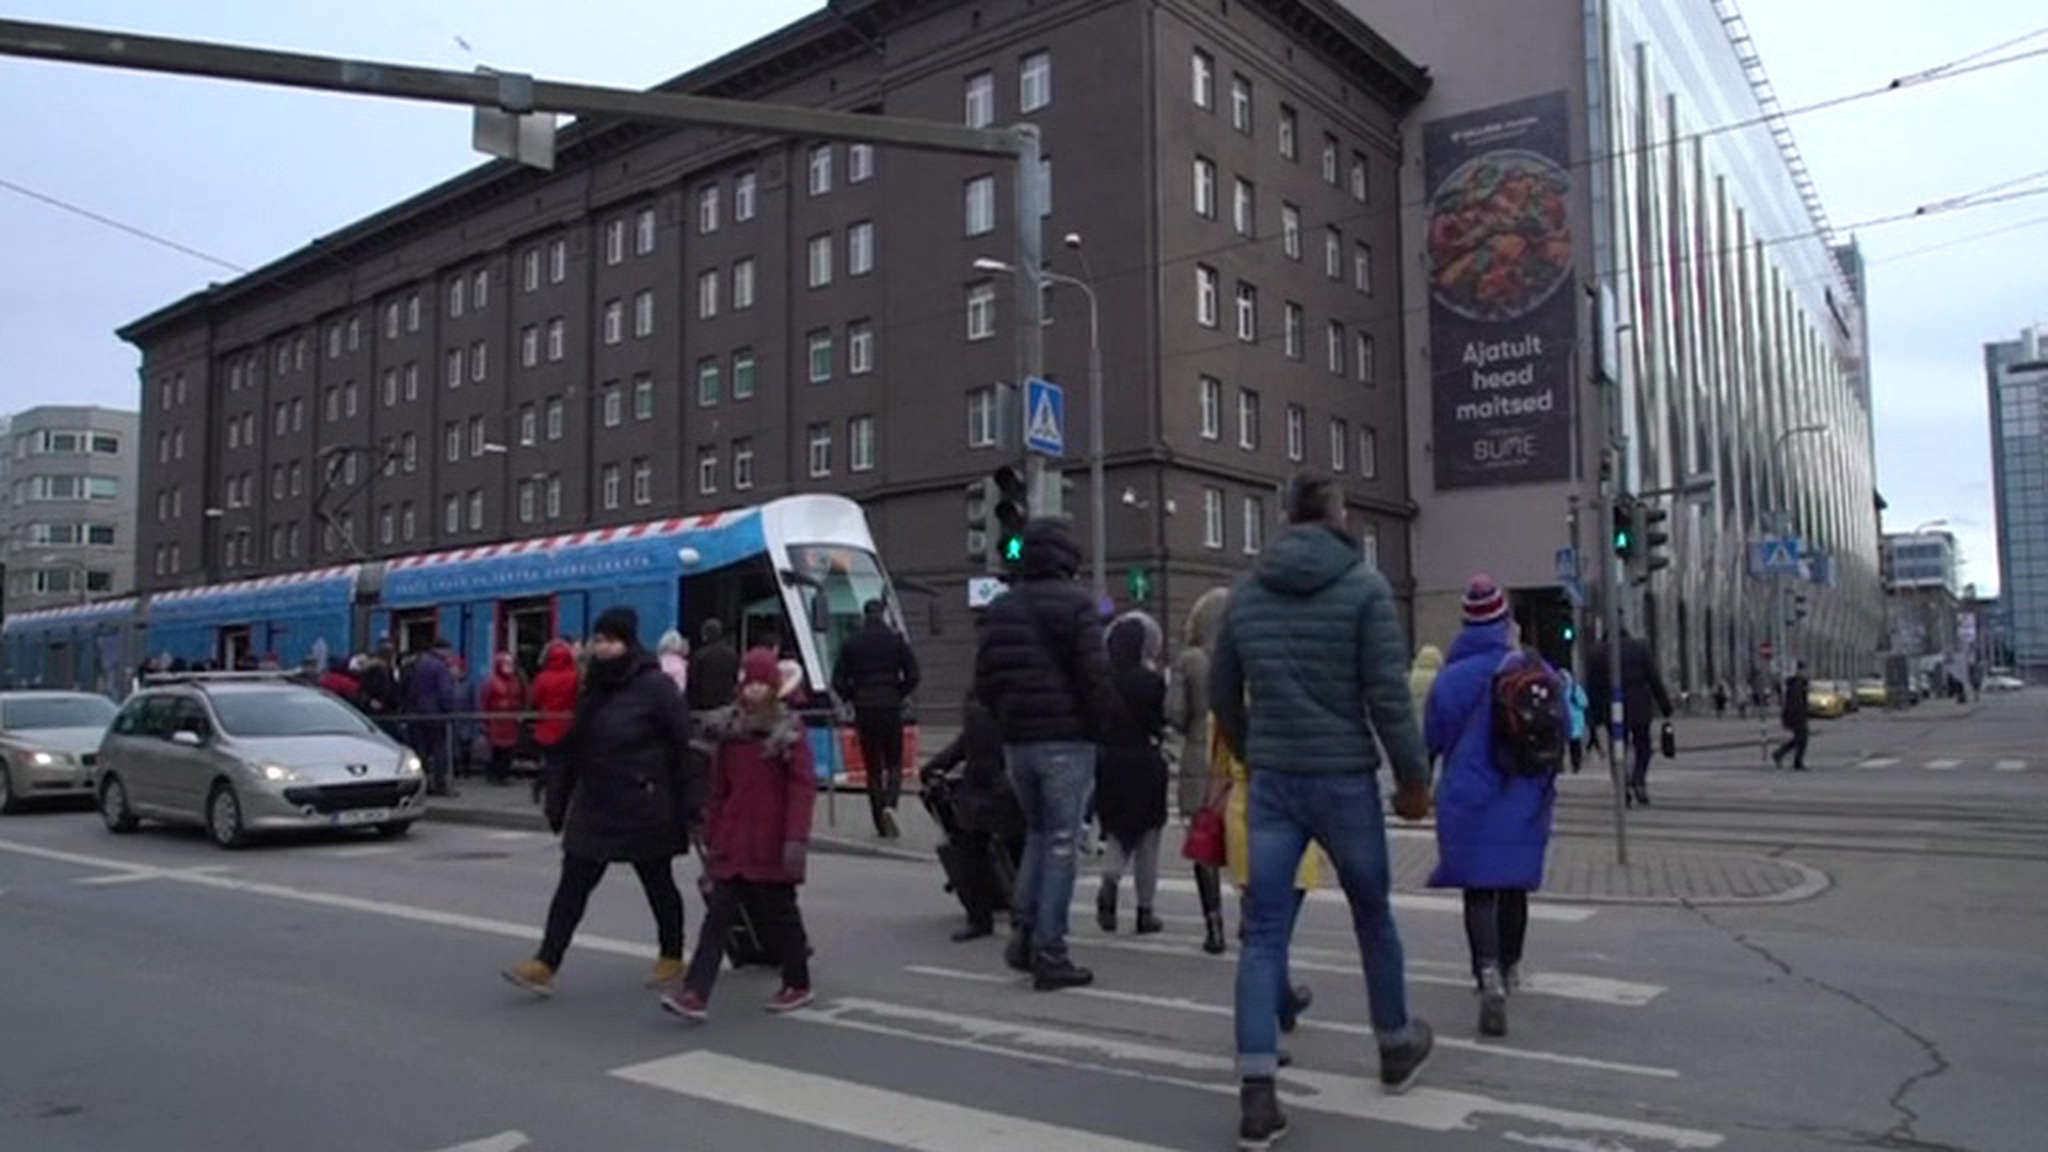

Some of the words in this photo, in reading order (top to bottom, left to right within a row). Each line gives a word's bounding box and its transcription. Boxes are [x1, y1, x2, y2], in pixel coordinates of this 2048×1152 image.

[1463, 335, 1542, 367] Ajatult
[1472, 363, 1534, 390] head
[1456, 389, 1553, 420] maitsed
